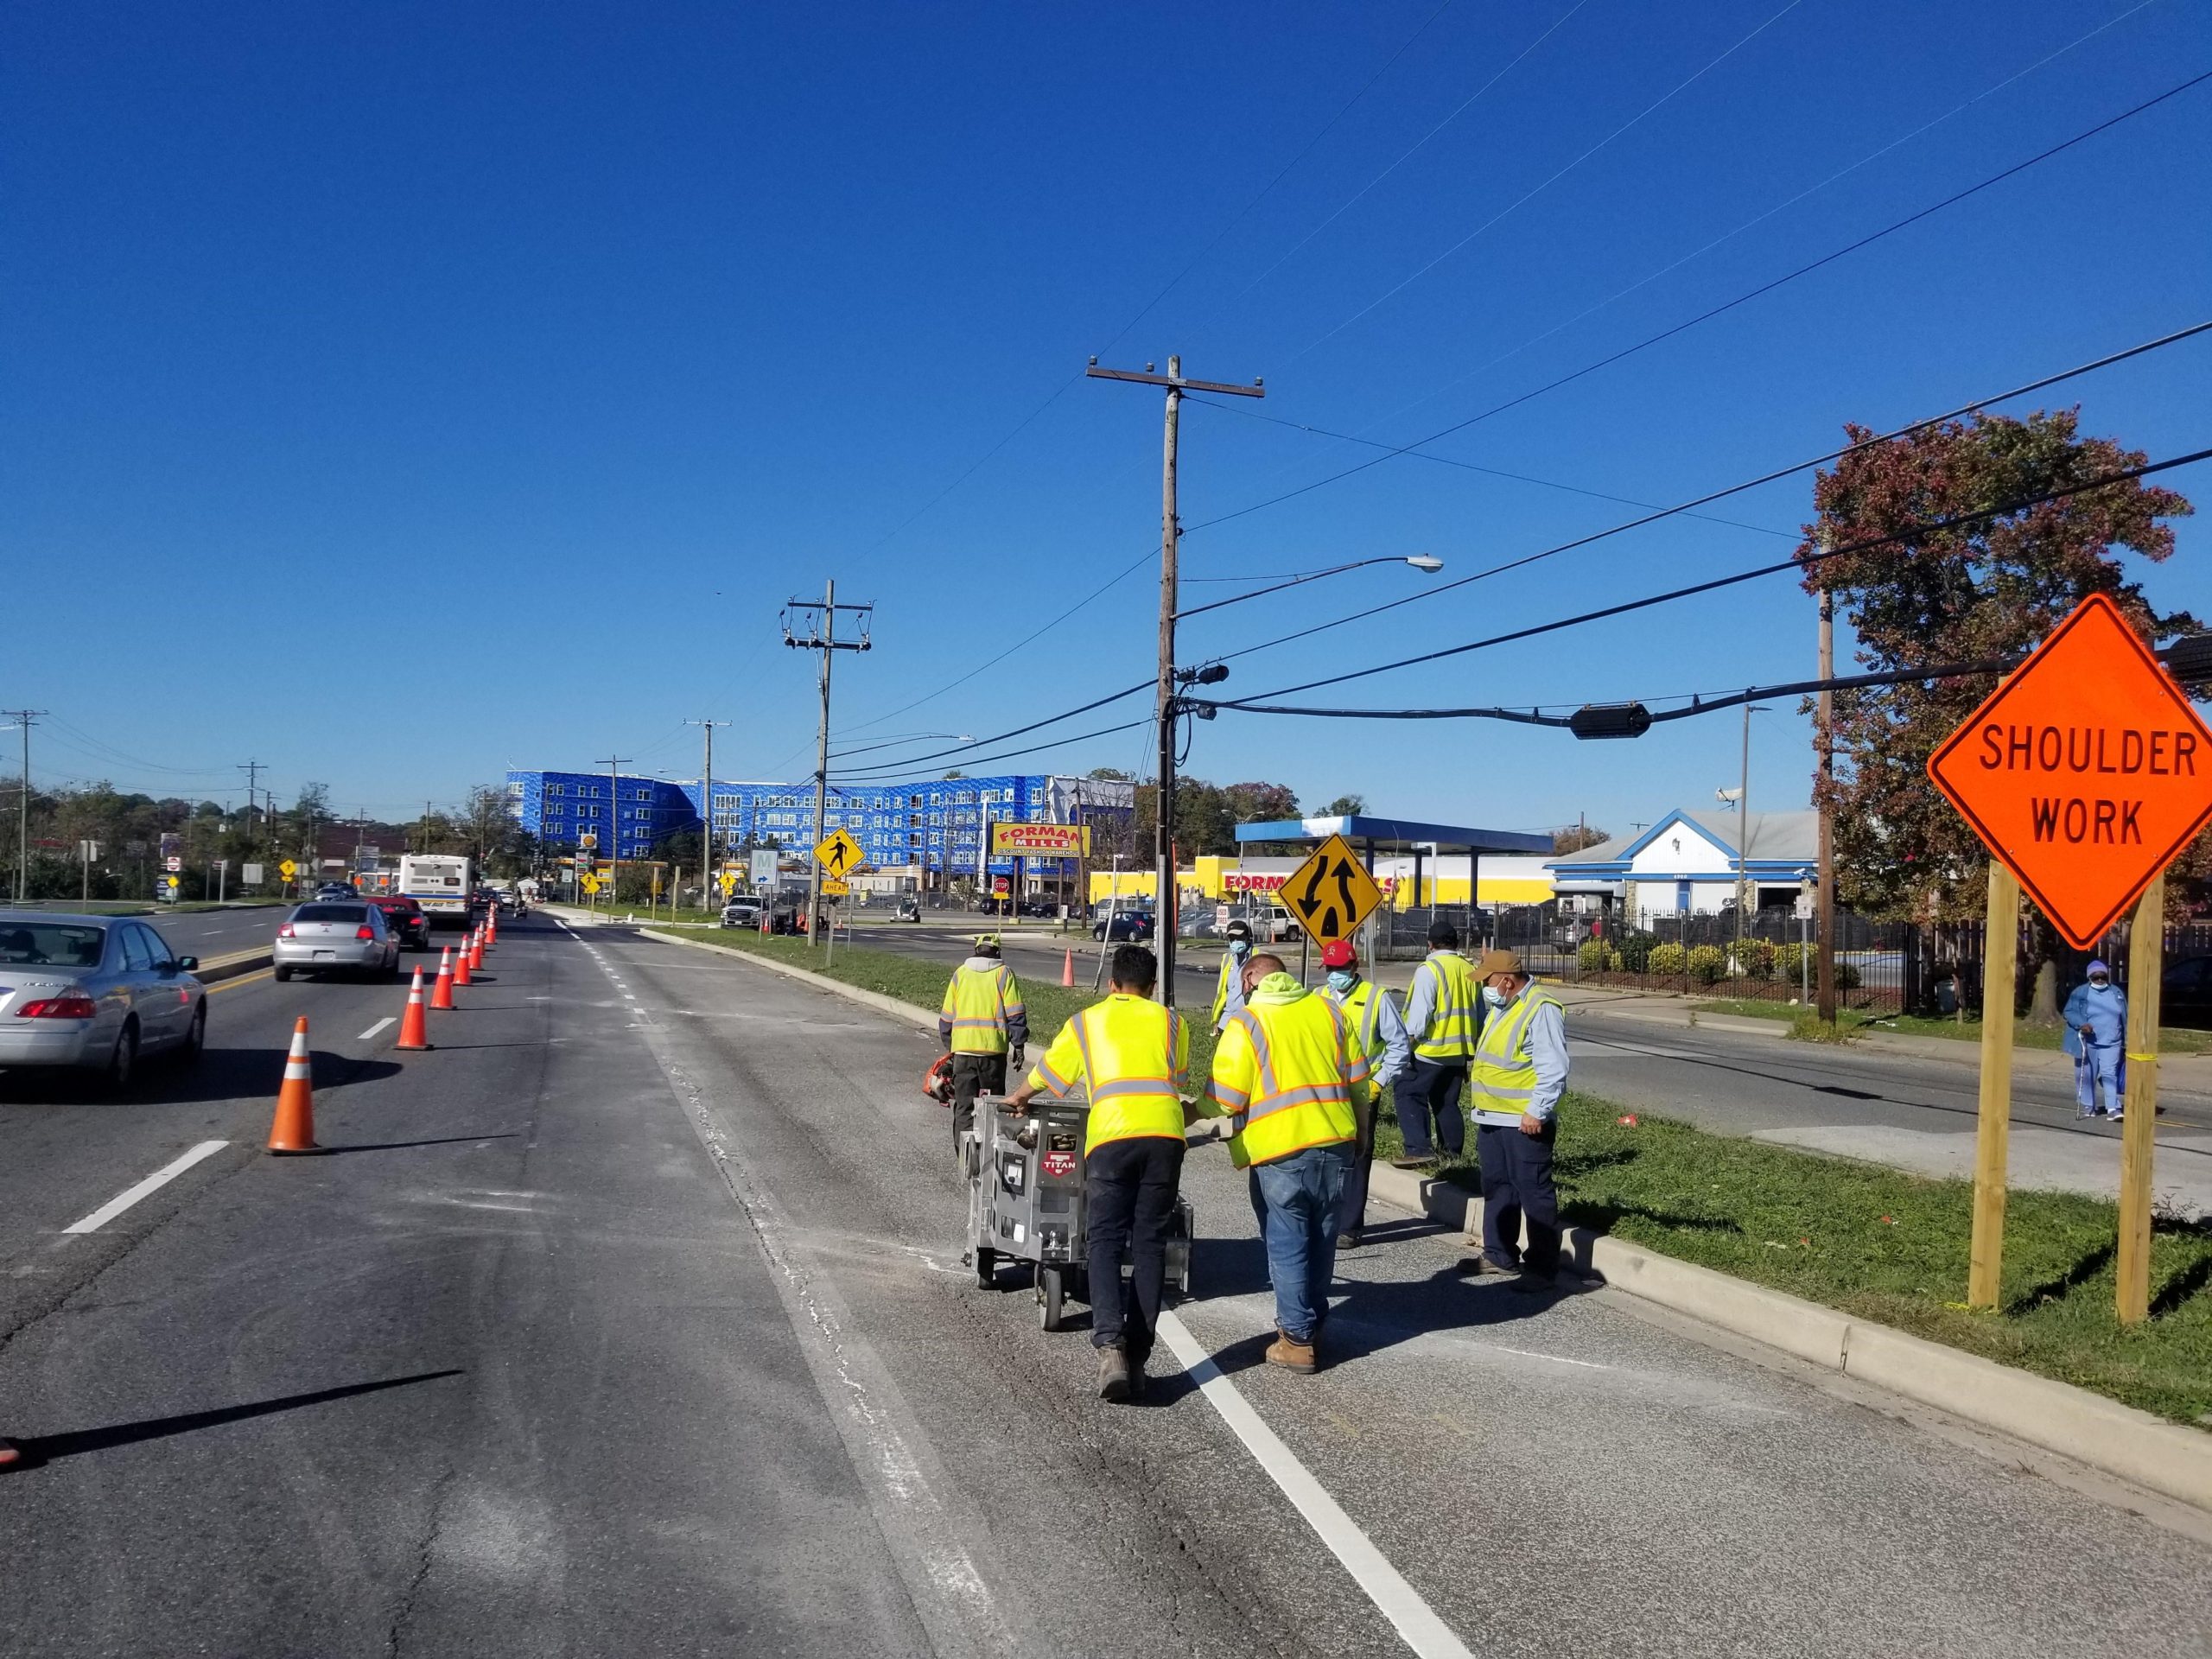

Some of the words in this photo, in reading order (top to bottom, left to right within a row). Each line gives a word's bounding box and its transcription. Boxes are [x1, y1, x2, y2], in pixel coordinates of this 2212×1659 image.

[1979, 723, 2197, 777] SHOULDER
[2031, 797, 2144, 845] WORK
[1014, 838, 1069, 847] MILLS
[1224, 875, 1284, 891] FORM
